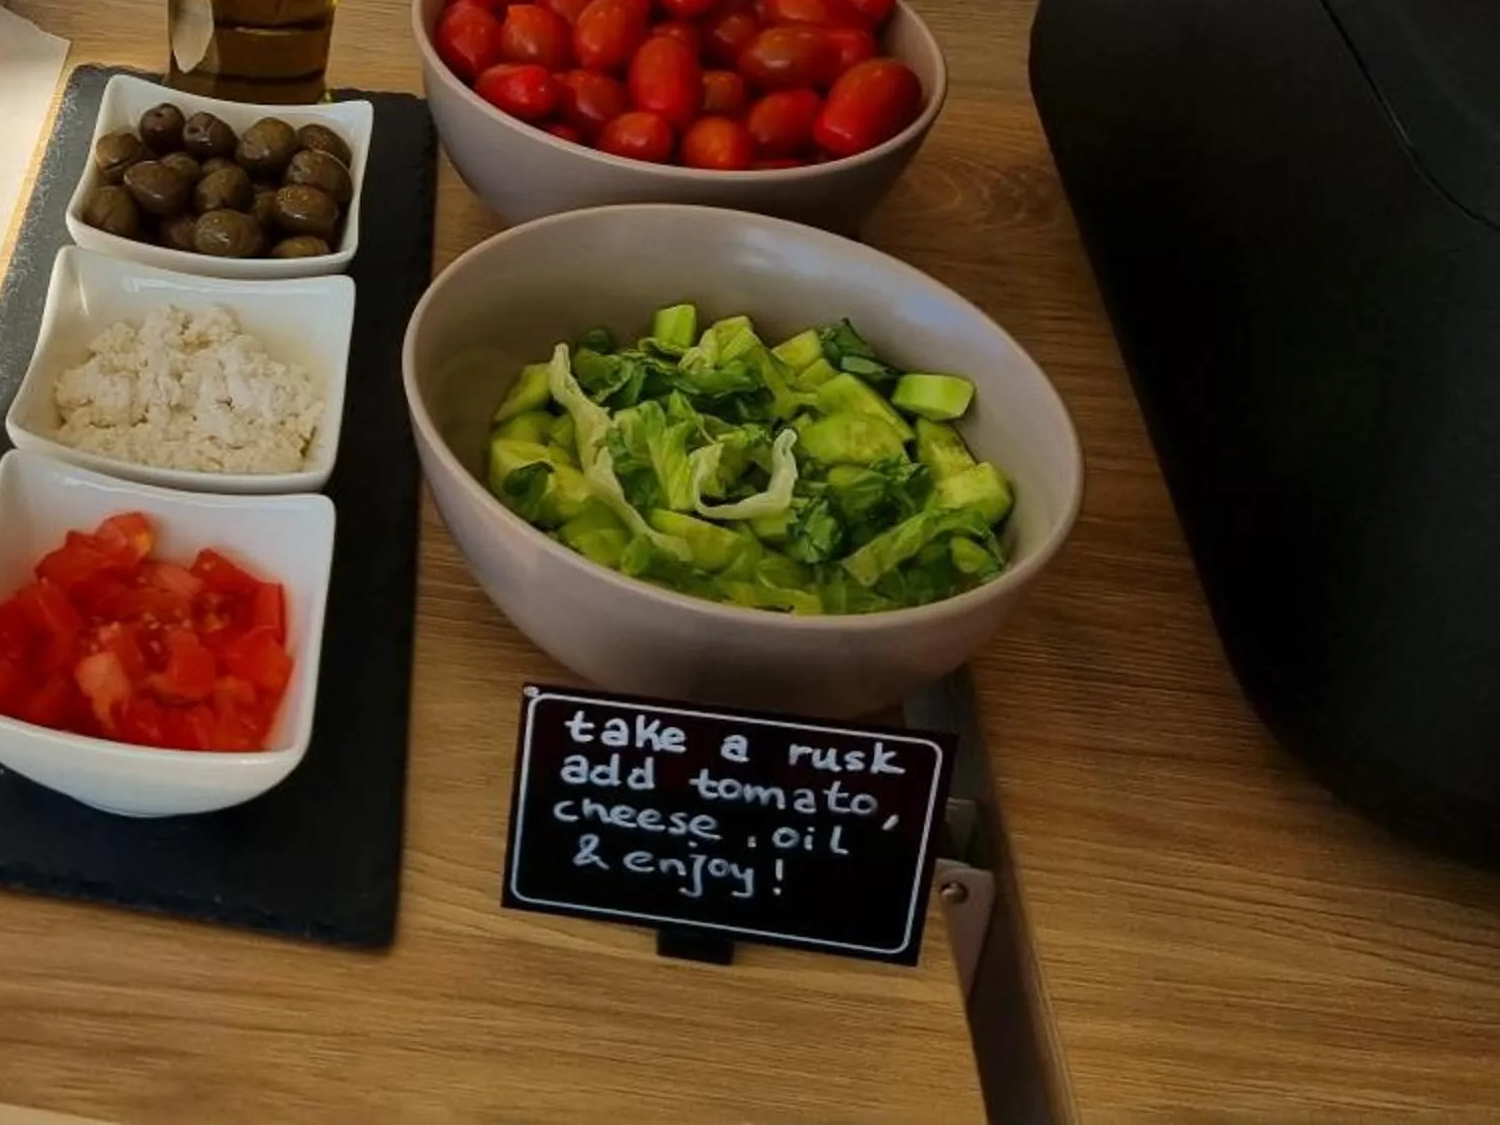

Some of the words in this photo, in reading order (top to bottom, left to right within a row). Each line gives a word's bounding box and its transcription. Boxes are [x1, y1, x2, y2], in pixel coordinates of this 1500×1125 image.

[564, 710, 687, 754] take
[720, 734, 750, 763] a
[788, 742, 906, 775] rusk
[560, 754, 655, 791] add
[572, 833, 610, 870] &
